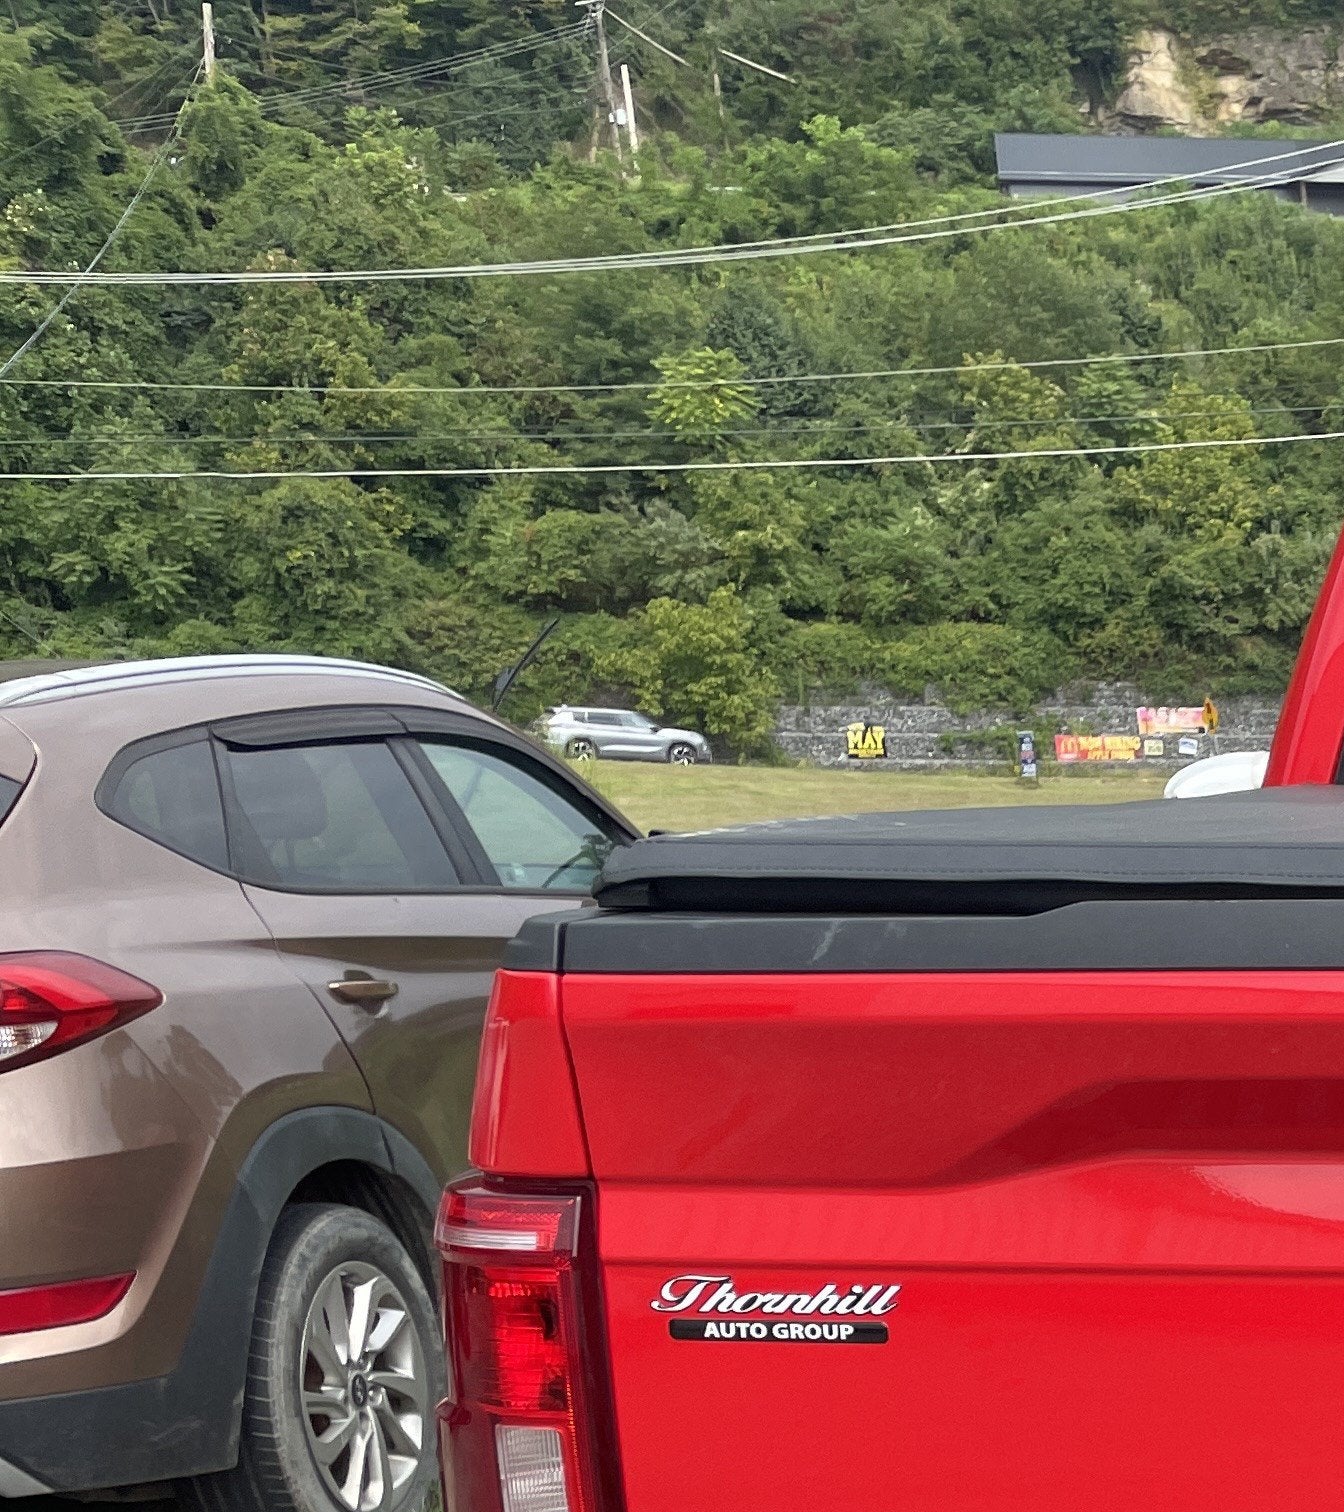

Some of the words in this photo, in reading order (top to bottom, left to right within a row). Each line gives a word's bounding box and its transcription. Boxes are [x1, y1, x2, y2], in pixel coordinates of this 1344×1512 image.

[651, 1274, 901, 1316] Thornhill
[704, 1322, 766, 1339] AUTO
[772, 1323, 854, 1340] GROUP
